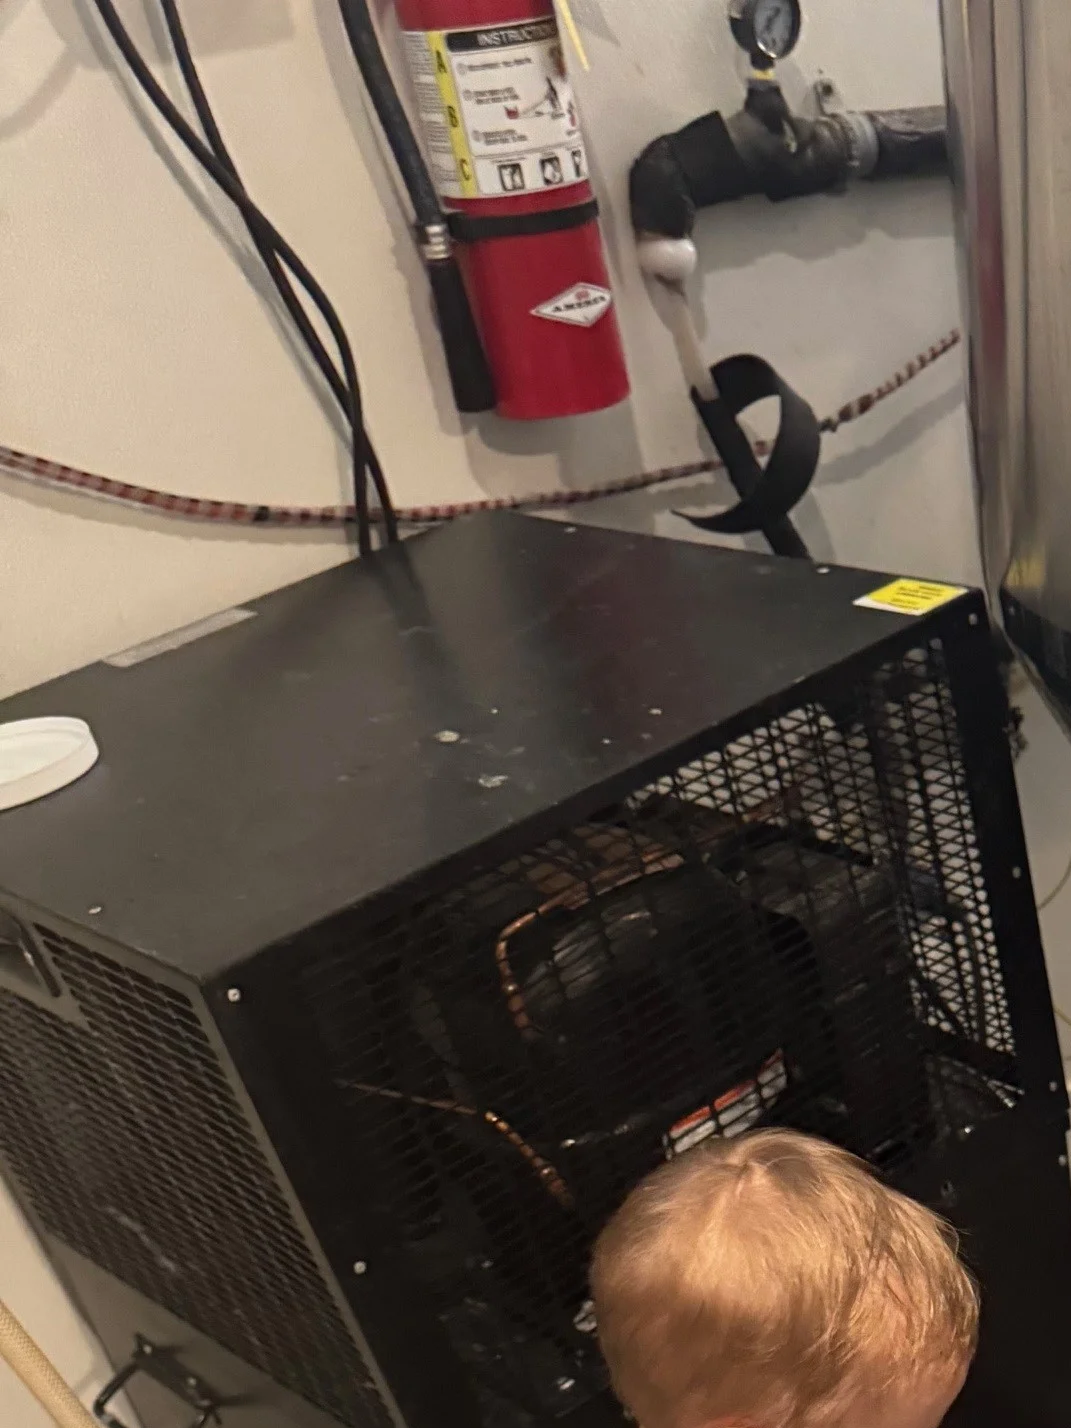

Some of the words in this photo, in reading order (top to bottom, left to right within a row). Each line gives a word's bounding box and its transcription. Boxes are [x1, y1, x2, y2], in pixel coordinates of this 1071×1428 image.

[436, 50, 448, 74] A
[447, 105, 459, 128] B
[461, 158, 471, 181] C
